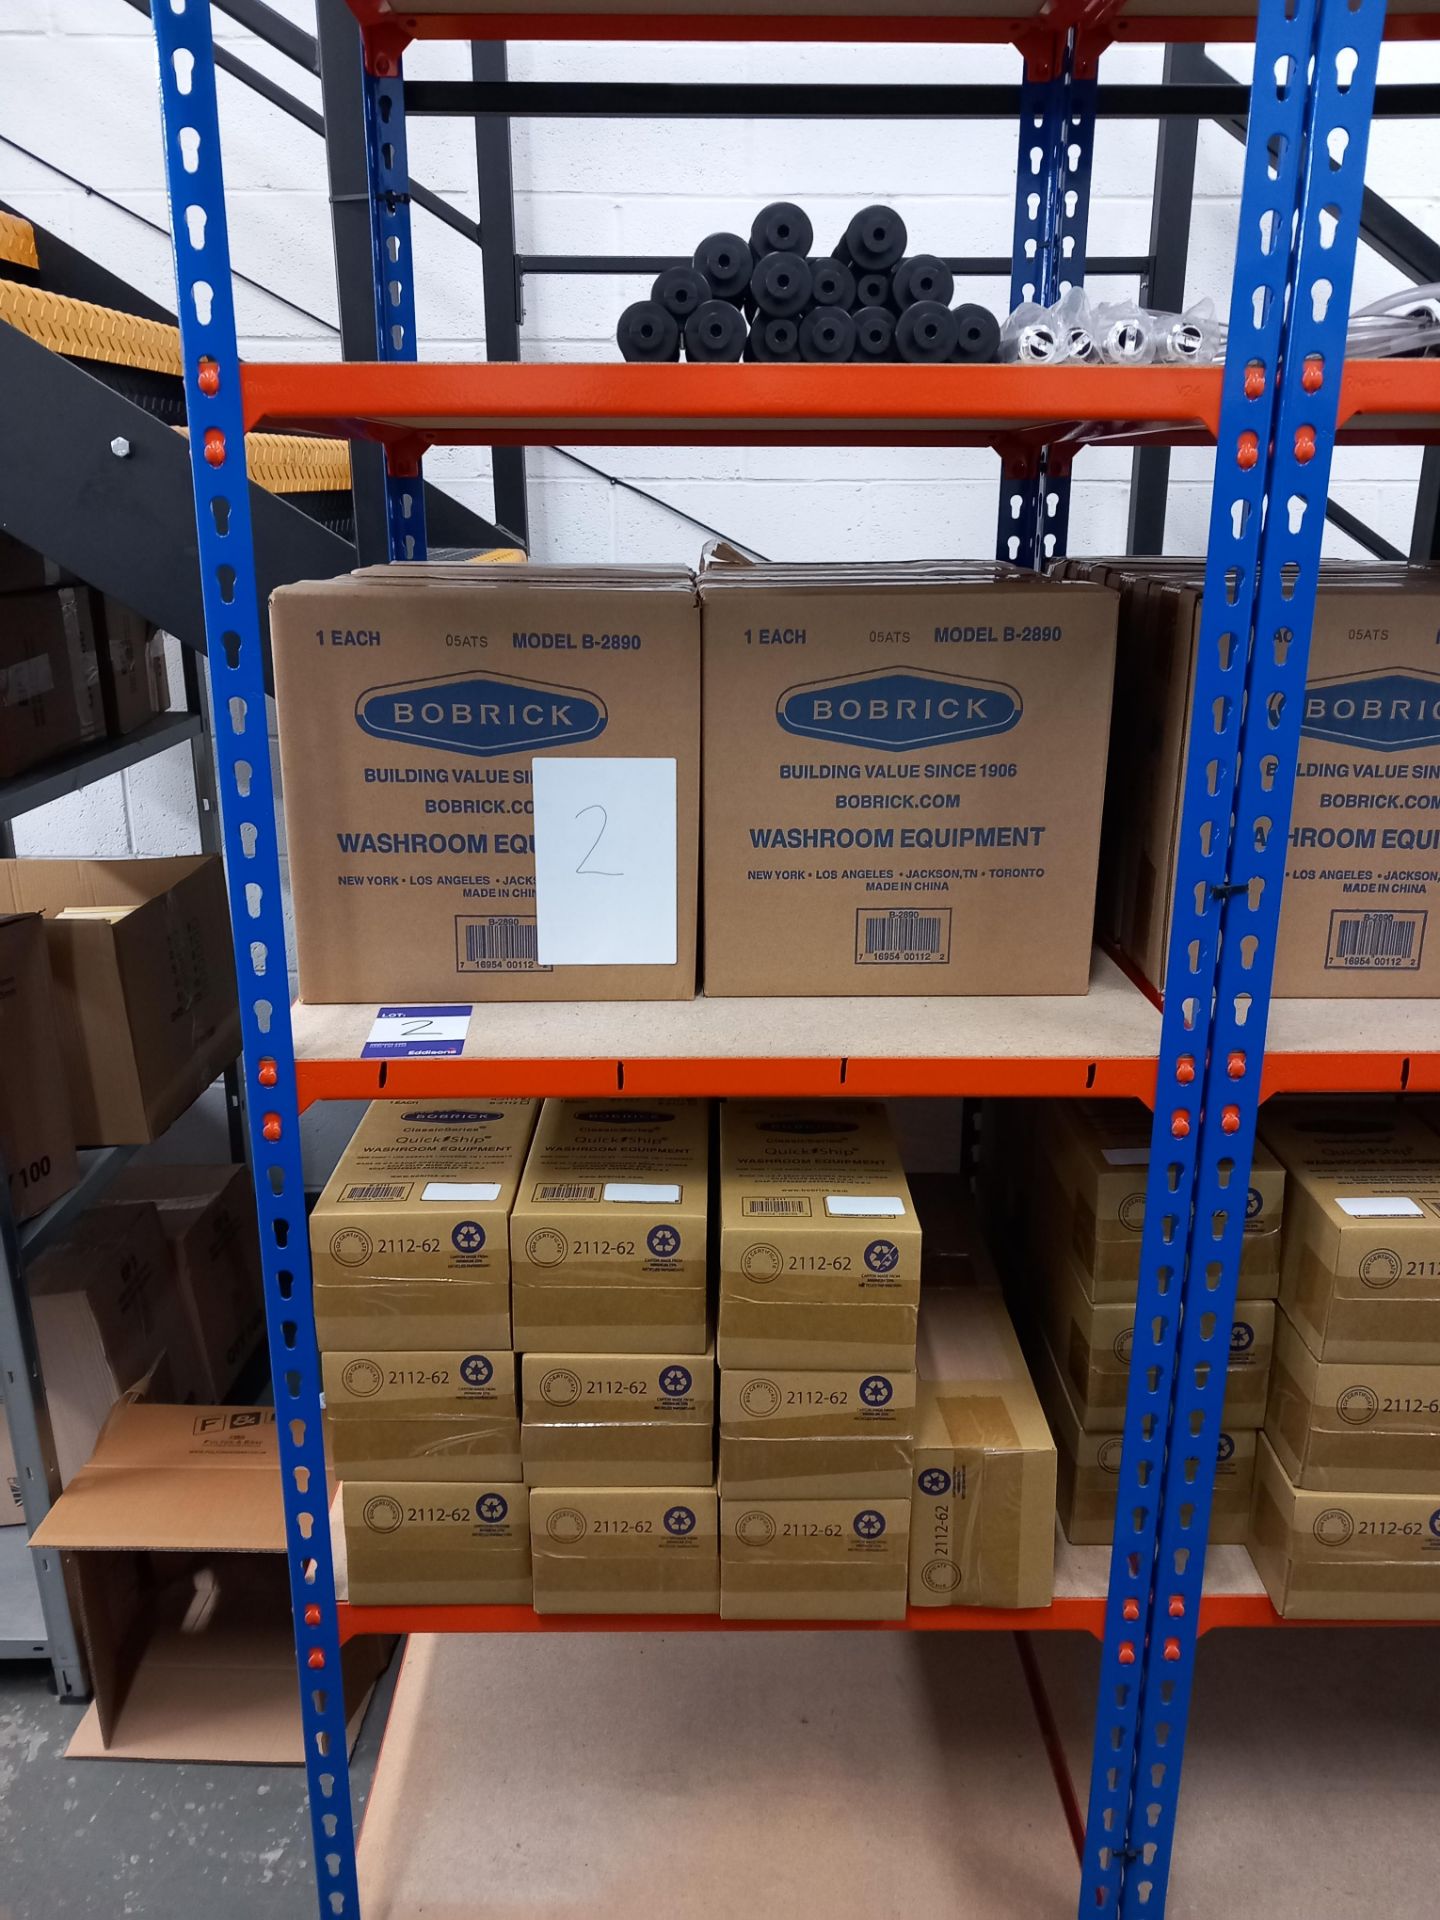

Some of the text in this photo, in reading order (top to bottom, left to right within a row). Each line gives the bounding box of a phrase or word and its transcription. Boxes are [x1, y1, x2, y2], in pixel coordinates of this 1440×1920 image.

[316, 631, 381, 647] 1 EACH
[445, 634, 488, 648] 05ATS
[512, 633, 642, 651] MODEL B-2890
[744, 629, 807, 645] 1 EACH
[869, 631, 911, 644] 05ATS
[934, 626, 1062, 644] MODEL B-2890
[1348, 629, 1390, 641] 05ATS
[394, 702, 573, 726] BOBRICK
[812, 698, 988, 721] BOBRICK
[364, 768, 449, 784] BUILDING
[452, 769, 510, 784] VALUE
[779, 762, 1017, 780] BUILDING VALUE SINCE 1906
[1353, 764, 1409, 779] VALUE
[835, 794, 961, 810] BOBRICK.COM
[337, 833, 488, 854] WASHROOM
[575, 805, 625, 876] 2
[749, 826, 1047, 849] WASHROOM EQUIPMENT
[338, 876, 365, 886] NEW
[366, 876, 399, 886] YORK
[410, 876, 433, 886] LOS
[437, 876, 491, 885] ANGELES
[747, 868, 1045, 881] NEW YORK LOS ANGELES JACKSON,TN TORONTO
[1292, 870, 1316, 880] LOS
[1319, 870, 1373, 880] ANGELES
[462, 888, 496, 898] MADE
[498, 888, 510, 898] IN
[865, 882, 949, 892] MADE IN CHINA
[1342, 883, 1427, 894] MADE IN CHINA
[858, 952, 945, 961] 7 16954 00112 2
[1344, 957, 1370, 966] 16954
[1374, 957, 1402, 966] 00112
[1410, 958, 1416, 966] 2
[460, 961, 465, 969] 7
[475, 961, 503, 969] 16954
[506, 961, 534, 969] 00112
[401, 1019, 444, 1036] 2
[19, 1155, 51, 1188] 100
[377, 1238, 441, 1253] 2112-62
[573, 1240, 635, 1255] 2112-62
[788, 1256, 852, 1271] 2112-62
[1405, 1261, 1440, 1276] 211
[388, 1371, 450, 1385] 2112-62
[586, 1381, 648, 1394] 2112-62
[786, 1391, 848, 1405] 2112-62
[407, 1508, 471, 1522] 2112-62
[594, 1520, 653, 1534] 2112-62
[782, 1524, 842, 1537] 2112-62
[934, 1505, 949, 1556] 2112-62
[1358, 1521, 1423, 1536] 2112-62
